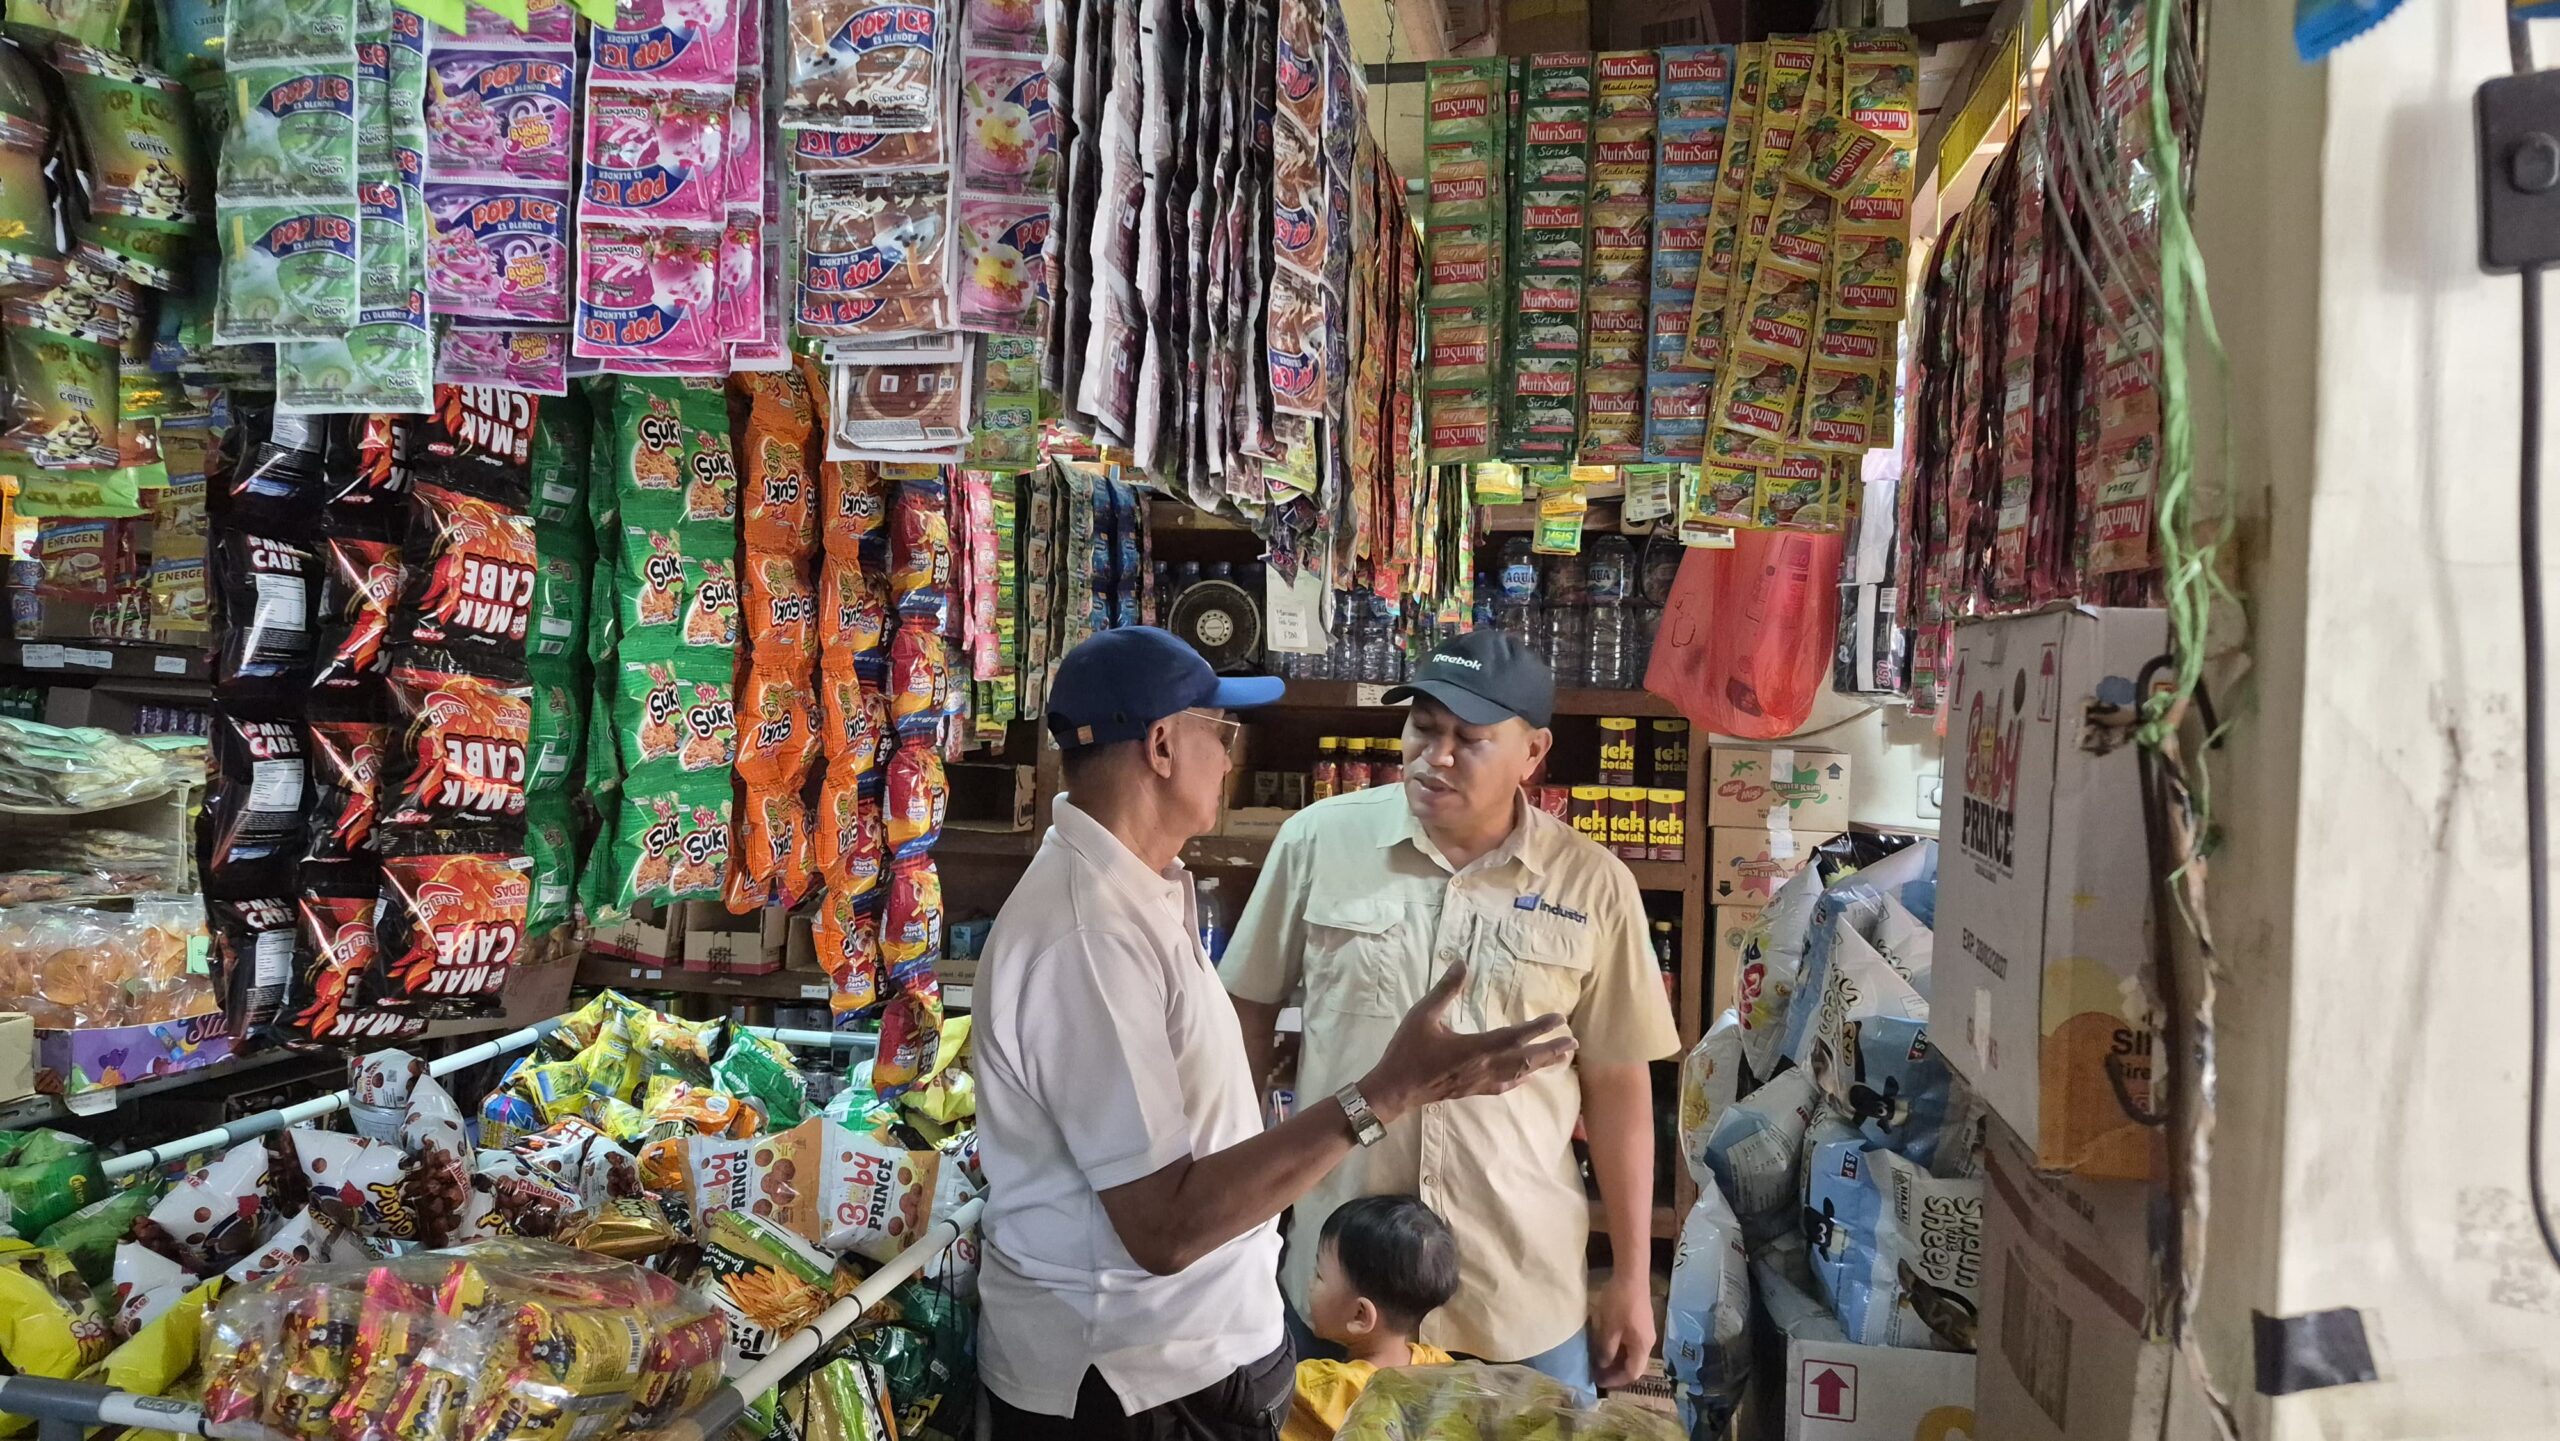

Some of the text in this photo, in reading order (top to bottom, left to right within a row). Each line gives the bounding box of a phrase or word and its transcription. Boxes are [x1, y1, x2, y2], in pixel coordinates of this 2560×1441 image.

[313, 22, 344, 34] Melon
[850, 10, 895, 42] POP
[635, 34, 675, 67] POP
[1535, 55, 1586, 65] NutriSari
[1602, 60, 1654, 76] NutriSari
[1777, 53, 1811, 68] NutriS
[479, 64, 521, 94] POP
[1543, 69, 1575, 77] Sirsak
[1668, 63, 1721, 80] NutriSari
[272, 80, 313, 109] POP
[515, 84, 547, 93] BLENDER
[305, 100, 335, 109] BLENDER
[598, 107, 649, 119] Strawberr
[1854, 111, 1907, 129] NutriSari
[359, 132, 392, 145] Melon
[511, 125, 551, 141] Bubble
[521, 134, 548, 148] Gum
[1530, 127, 1582, 141] NutriSari
[1538, 146, 1572, 156] Sirsak
[1665, 146, 1718, 161] NutriSari
[312, 163, 344, 177] Melon
[633, 170, 642, 179] ES
[626, 174, 668, 203] POP
[472, 198, 514, 230] POP
[1850, 198, 1900, 216] NutriSari
[1526, 208, 1578, 225] NutriSari
[271, 219, 313, 251] POP
[498, 221, 542, 231] ES BLENDER
[293, 239, 335, 249] ES BLENDER
[1535, 230, 1567, 241] Sirsak
[506, 264, 546, 280] Bubble
[841, 254, 882, 287] POP
[519, 274, 546, 288] Gum
[1522, 291, 1574, 309] NutriSari
[1844, 286, 1896, 306] NutriSari
[314, 304, 347, 318] Melon
[1530, 314, 1564, 324] Sirsak
[621, 313, 662, 343] POP
[1756, 318, 1805, 347] NutriSari
[1824, 333, 1876, 354] NutriSari
[1519, 375, 1570, 392] NutriSari
[461, 384, 530, 428] CABE
[1527, 397, 1559, 408] Sirsak
[1589, 395, 1639, 411] NutriSari
[1733, 402, 1783, 430] NutriSari
[461, 413, 513, 454] MAK
[1435, 427, 1485, 444] NutriSari
[1814, 421, 1864, 442] NutriSari
[162, 483, 206, 498] ENERGE
[47, 534, 99, 548] ENERGEN
[253, 550, 302, 571] CABE
[158, 569, 204, 583] ENERGE
[462, 561, 535, 605] CABE
[1505, 571, 1535, 584] AQUA
[1590, 571, 1610, 582] QUA
[372, 582, 391, 600] 15
[454, 600, 513, 634] MAK
[1432, 653, 1482, 671] Reebok
[251, 736, 299, 756] CABE
[1601, 740, 1634, 759] teh
[446, 739, 525, 779] CABE
[1601, 761, 1633, 771] kotak
[440, 780, 509, 810] MAK
[1572, 810, 1606, 831] teh
[1610, 811, 1645, 831] teh
[1648, 813, 1684, 834] teh
[650, 824, 679, 854] SUK
[1610, 832, 1644, 843] kotak
[1648, 834, 1683, 845] kotak
[1962, 796, 2014, 868] PRINCE
[496, 885, 527, 896] PEDAS
[247, 910, 296, 928] CABE
[1539, 899, 1587, 924] industri
[438, 927, 516, 963] CABE
[337, 945, 355, 964] 15
[427, 967, 489, 993] MAK
[328, 1013, 404, 1036] MAK
[731, 1150, 749, 1210] RINCE
[516, 1178, 576, 1208] Chocolate
[867, 1158, 894, 1231] PRINCE
[1920, 1196, 1954, 1281] Sheep
